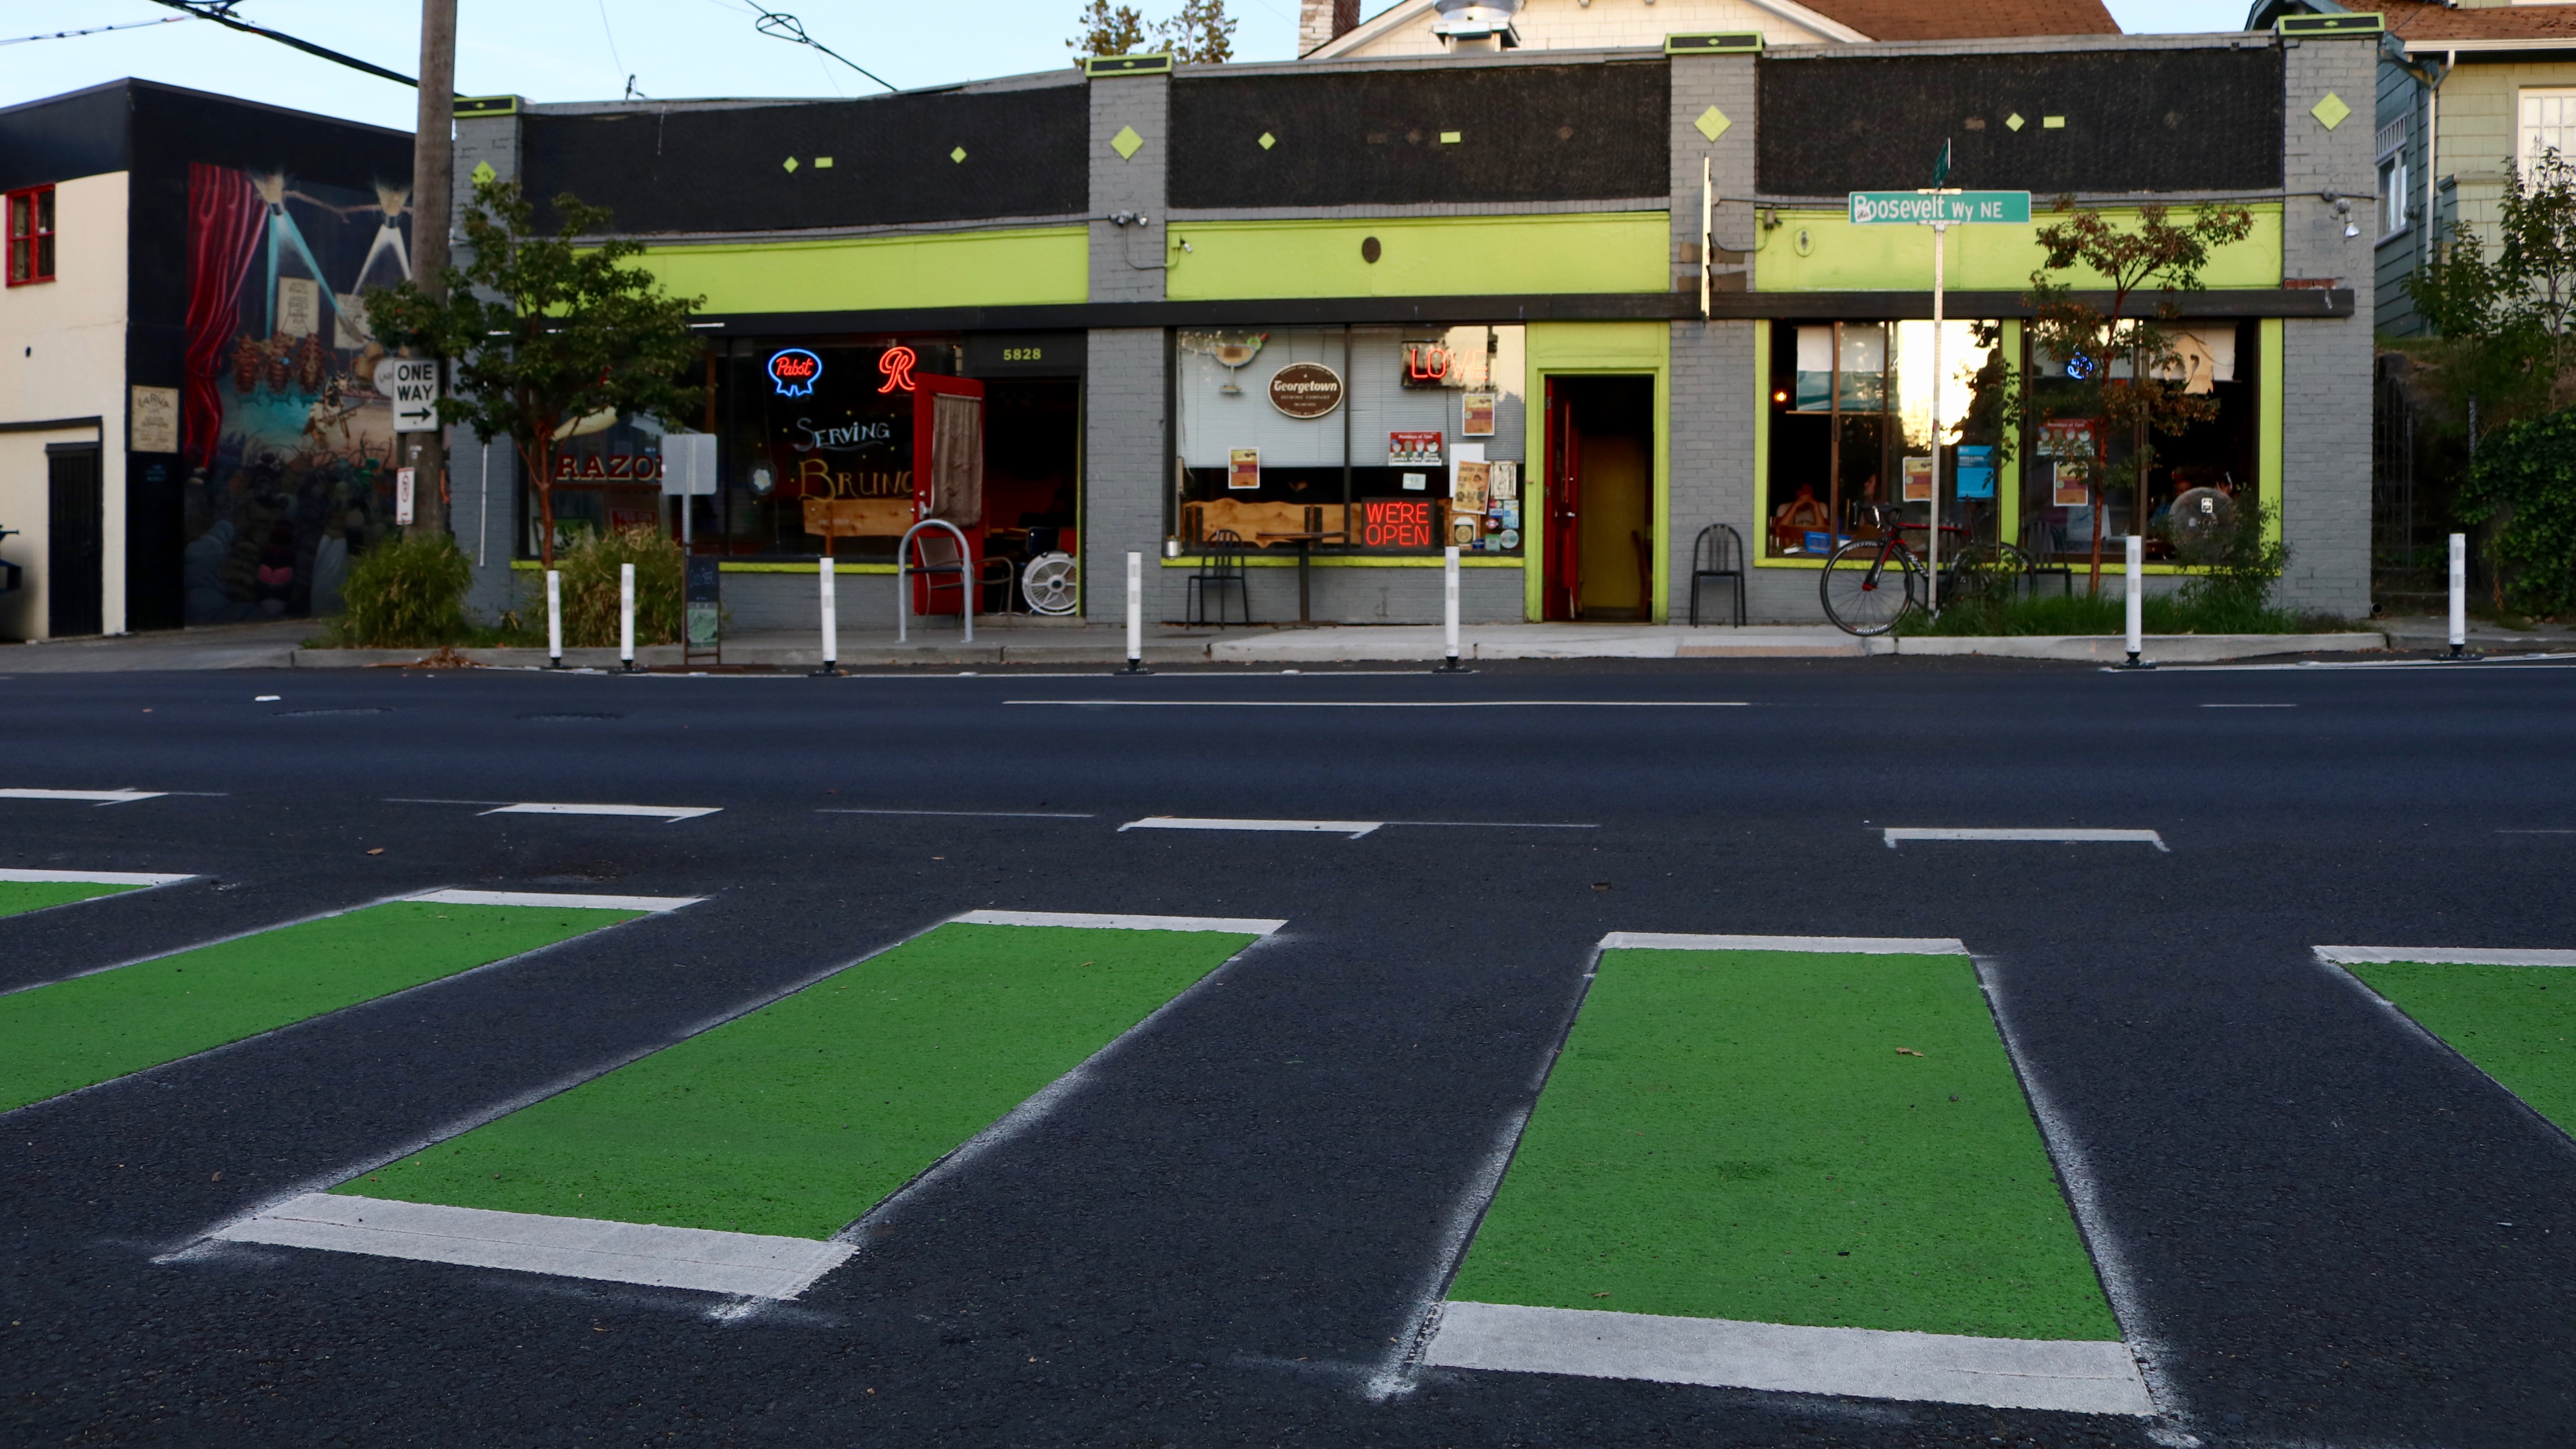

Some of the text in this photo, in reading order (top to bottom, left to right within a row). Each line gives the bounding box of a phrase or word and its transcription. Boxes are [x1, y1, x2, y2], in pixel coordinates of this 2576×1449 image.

[1854, 195, 1944, 219] Roosevelt
[1952, 202, 1973, 221] Wy
[1981, 201, 2003, 218] NE
[1003, 348, 1041, 361] 5828
[398, 364, 432, 380] ONE
[776, 357, 813, 376] Pabst
[1411, 348, 1488, 380] LOVE
[398, 384, 433, 401] WAY
[1274, 380, 1337, 394] Georgetown
[1366, 523, 1430, 546] OPEN
